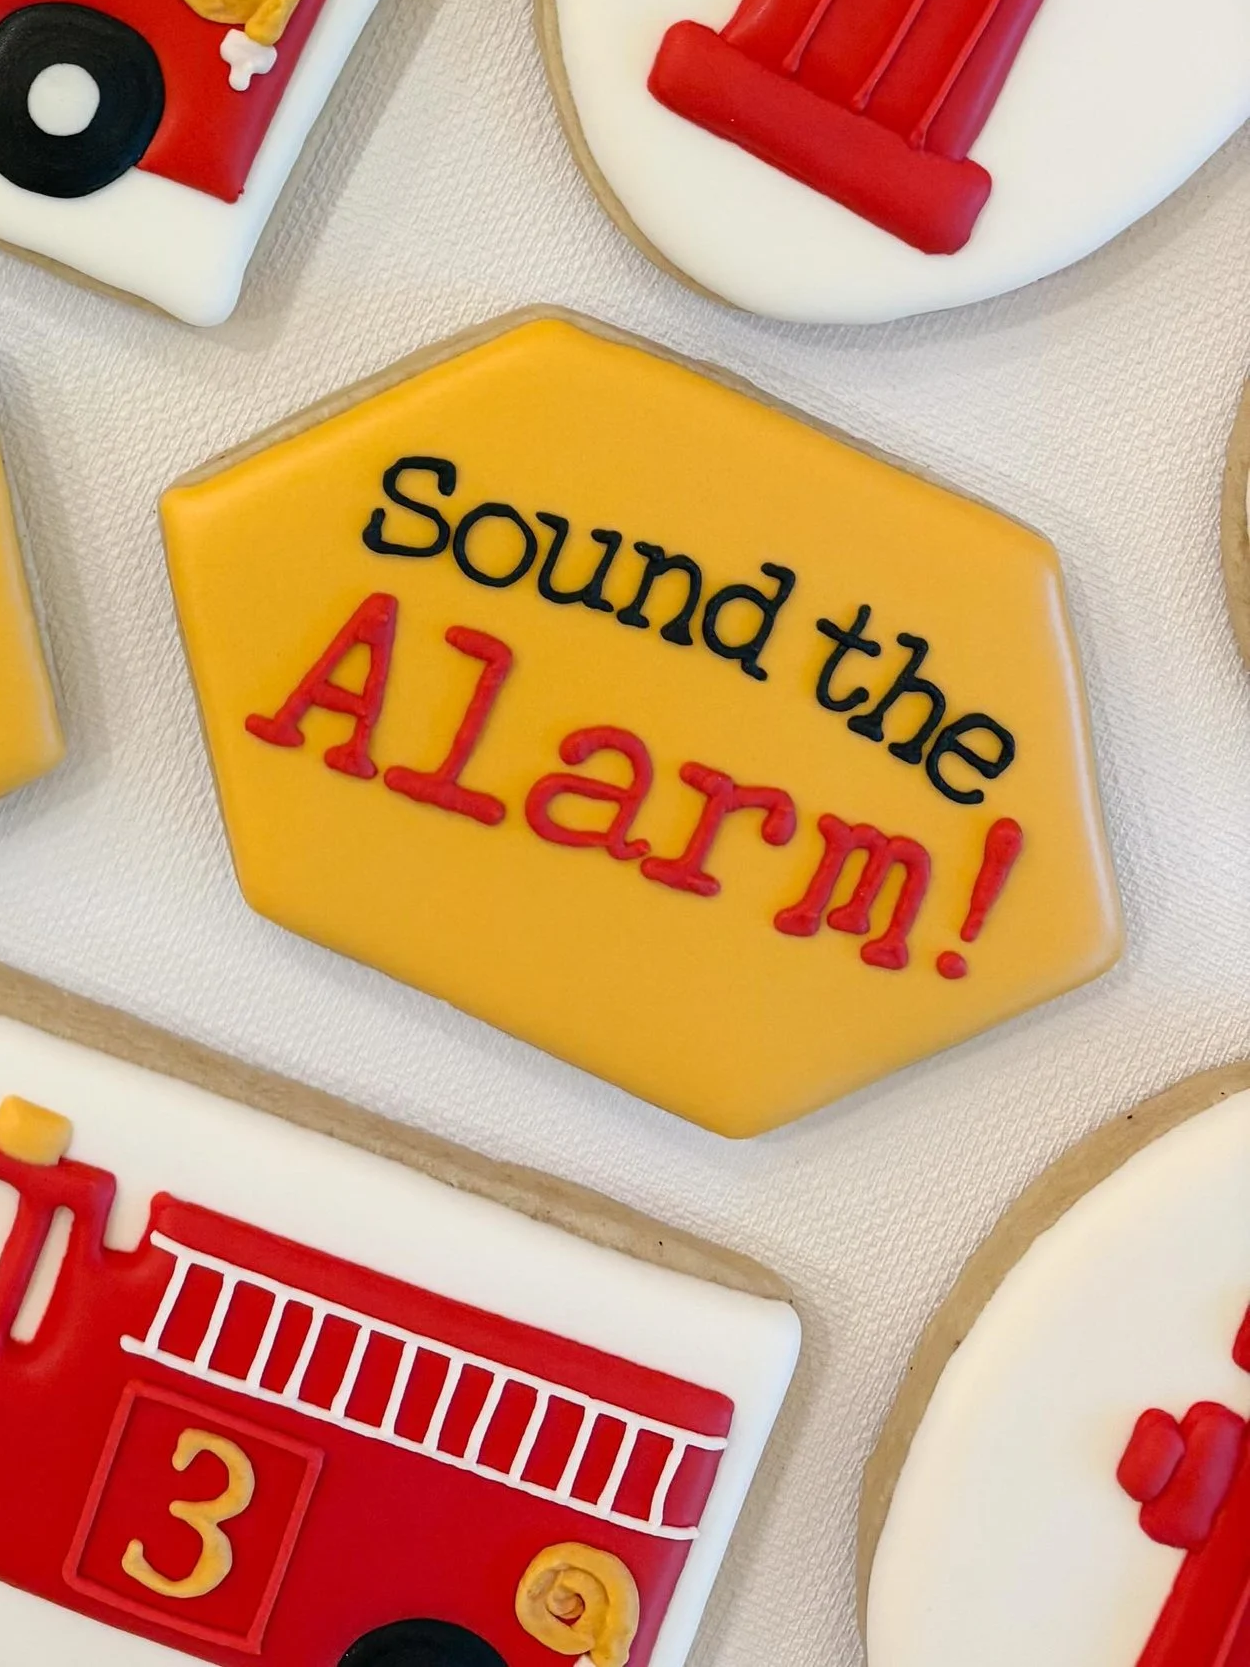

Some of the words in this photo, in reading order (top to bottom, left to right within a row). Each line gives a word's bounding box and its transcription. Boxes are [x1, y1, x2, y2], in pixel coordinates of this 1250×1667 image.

[244, 592, 1023, 980] Alarm!
[362, 456, 797, 681] Sound
[815, 603, 1016, 805] the
[121, 1428, 255, 1598] 3
